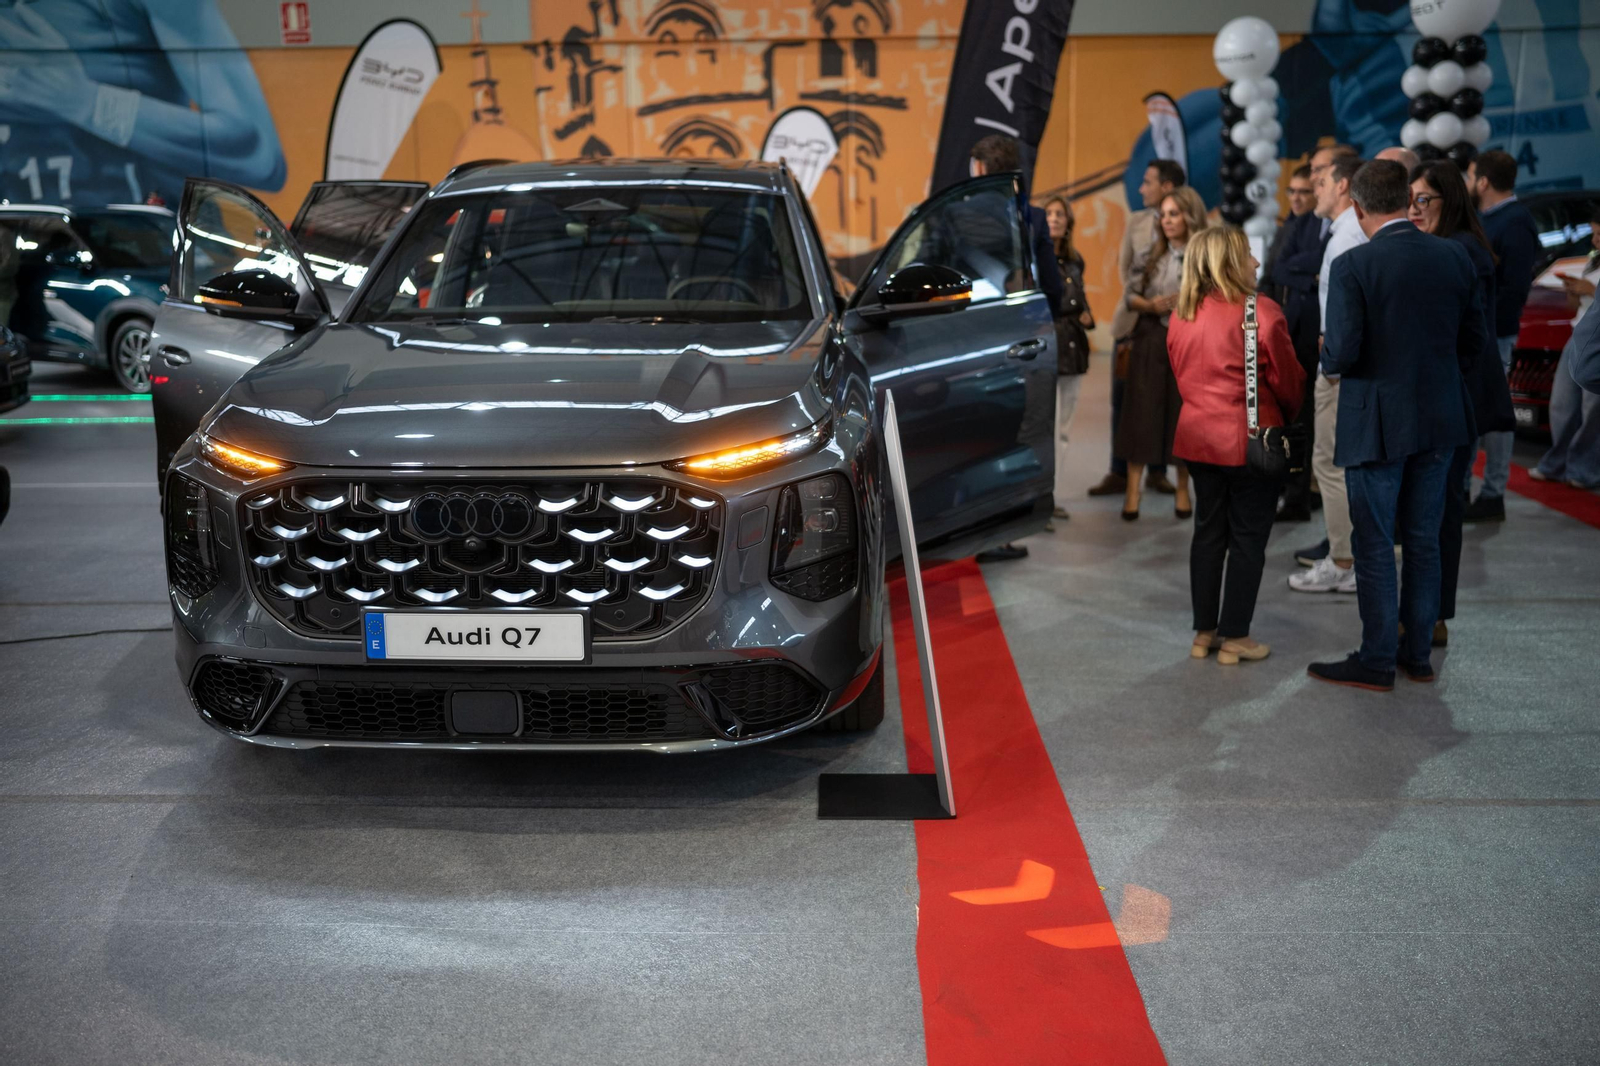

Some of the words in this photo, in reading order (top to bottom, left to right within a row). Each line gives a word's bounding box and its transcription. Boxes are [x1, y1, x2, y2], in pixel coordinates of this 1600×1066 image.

[361, 57, 425, 84] BYD
[18, 155, 73, 200] 17
[372, 640, 380, 649] E
[424, 627, 491, 645] Audi
[501, 627, 541, 648] Q7
